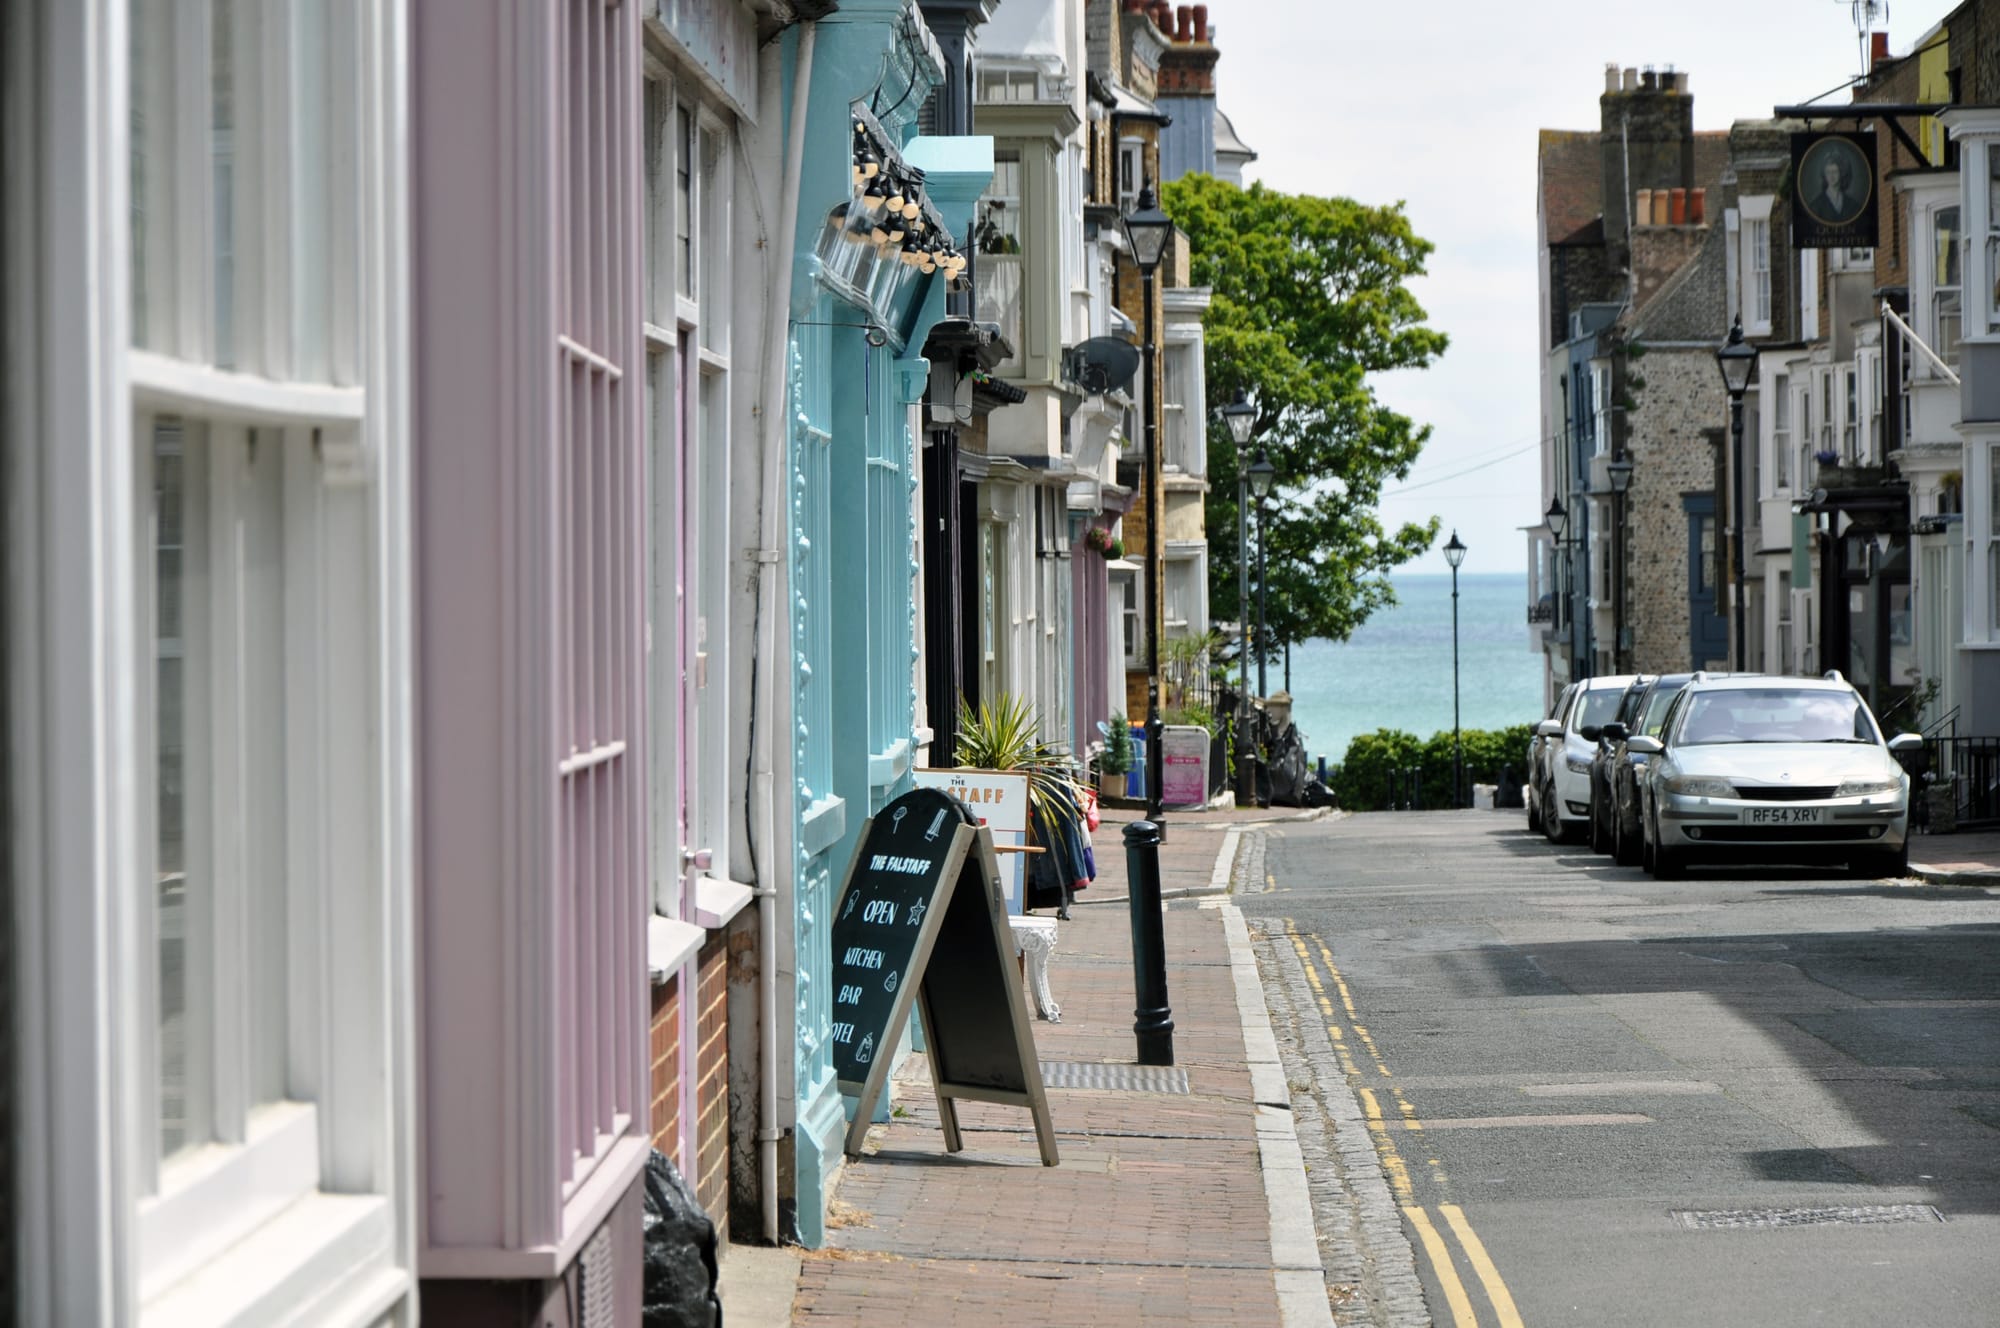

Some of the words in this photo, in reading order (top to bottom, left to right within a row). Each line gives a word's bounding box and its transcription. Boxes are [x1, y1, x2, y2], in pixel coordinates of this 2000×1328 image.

[1752, 809, 1788, 823] RF54
[1793, 808, 1819, 822] XRV
[870, 854, 888, 871] THE
[885, 856, 931, 875] FALSTAFF
[863, 900, 899, 925] OPEN
[843, 947, 885, 970] KITCHEN
[838, 984, 862, 1006] BAR
[831, 1022, 854, 1044] OTEL
